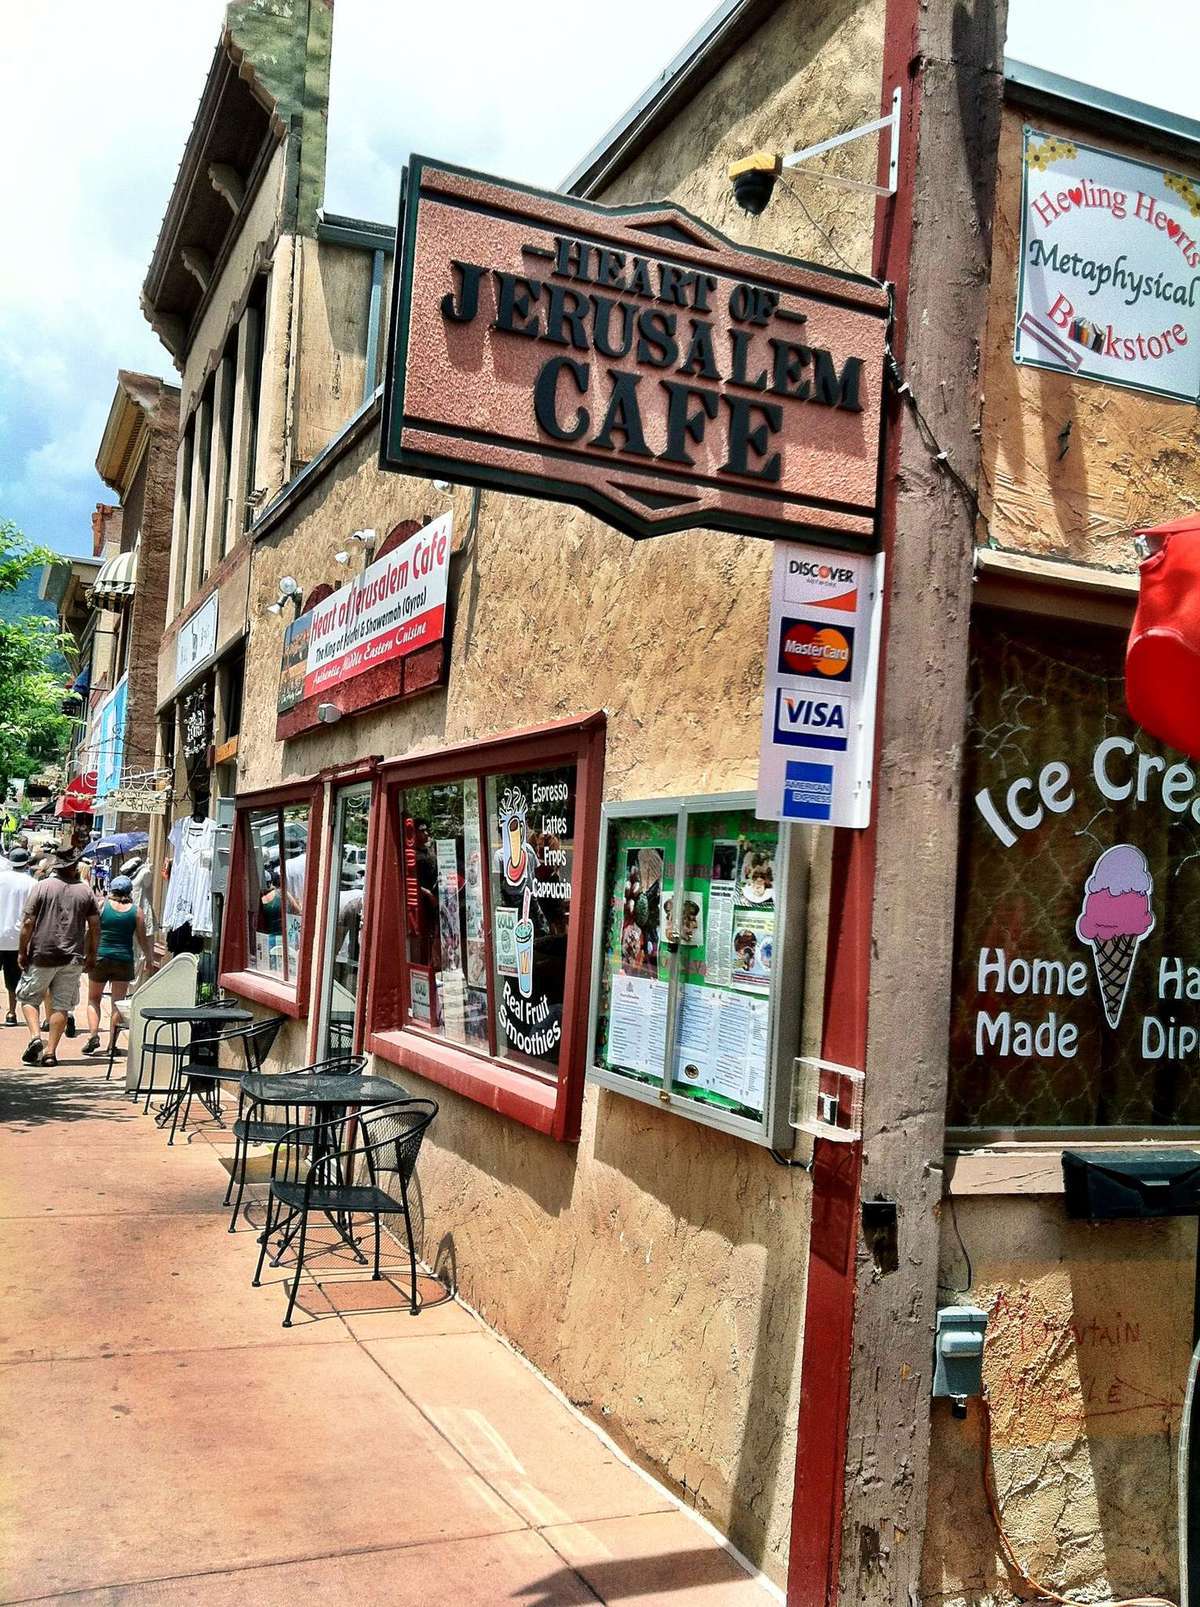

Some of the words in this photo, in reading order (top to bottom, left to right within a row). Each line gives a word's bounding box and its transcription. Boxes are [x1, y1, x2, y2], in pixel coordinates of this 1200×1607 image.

[1031, 178, 1128, 228] Heling
[1134, 191, 1200, 268] Herts
[552, 237, 717, 313] HEART
[729, 284, 780, 327] OF
[1030, 239, 1200, 306] Metaphysical
[441, 260, 865, 412] JERUSALEM
[1047, 292, 1188, 361] Bkstore
[534, 357, 783, 482] CAFE
[310, 602, 337, 647] Heart
[338, 592, 353, 628] of
[349, 560, 409, 628] Jerusalem
[413, 524, 447, 580] Café
[789, 560, 854, 584] DISCOVER
[363, 640, 393, 661] Eastern
[395, 621, 427, 646] Cuisine
[784, 639, 849, 661] MasterCard
[785, 697, 844, 729] VISA
[532, 783, 568, 803] Espresso
[975, 762, 1075, 848] Ice
[542, 815, 567, 835] Lattes
[532, 878, 572, 899] Cappuccin
[977, 947, 1088, 996] Home
[503, 981, 523, 1022] Real
[526, 994, 549, 1024] Fruit
[498, 1004, 561, 1055] Smoothies
[975, 1011, 1079, 1057] Made
[1142, 1016, 1200, 1060] Dip
